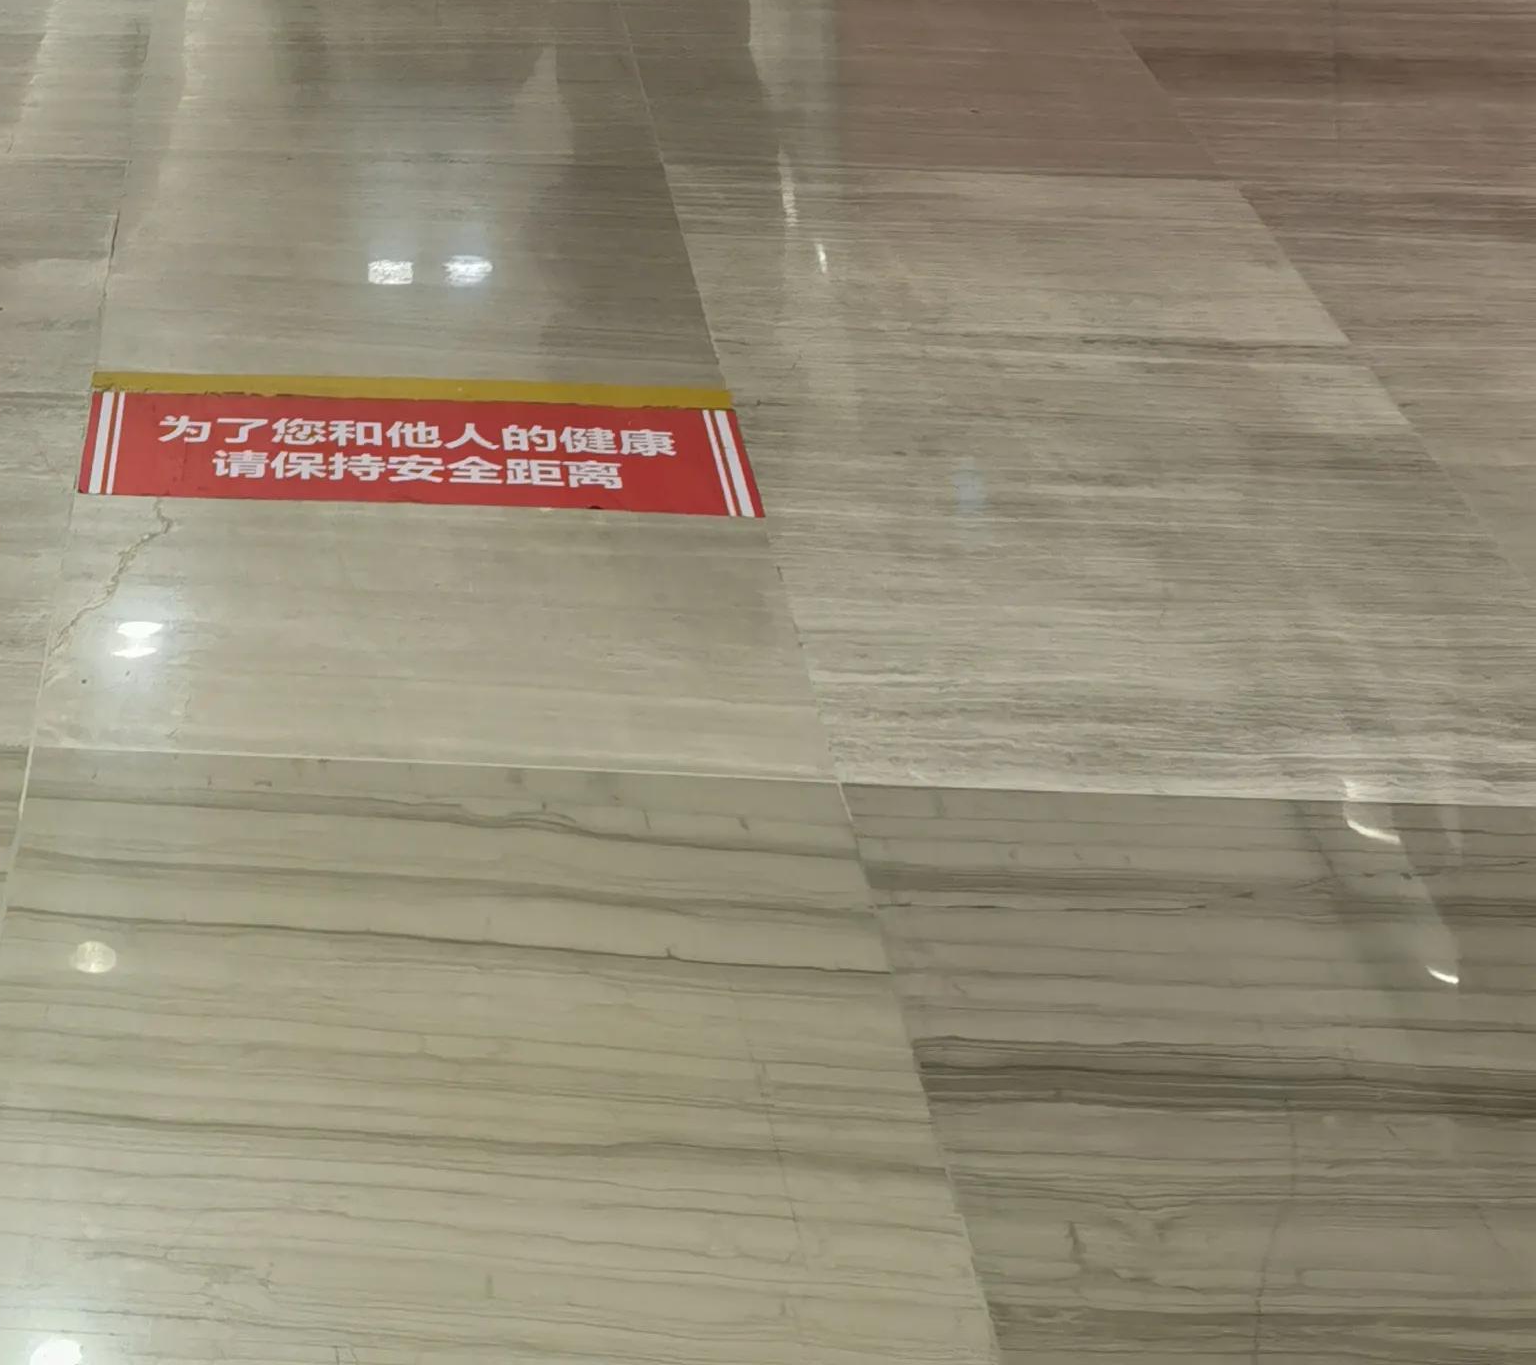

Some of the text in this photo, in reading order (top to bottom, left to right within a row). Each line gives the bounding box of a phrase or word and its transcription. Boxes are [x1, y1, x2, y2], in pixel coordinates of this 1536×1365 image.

[158, 415, 675, 456] 为了您和他人的健康
[212, 451, 622, 490] 请保持安全距离
